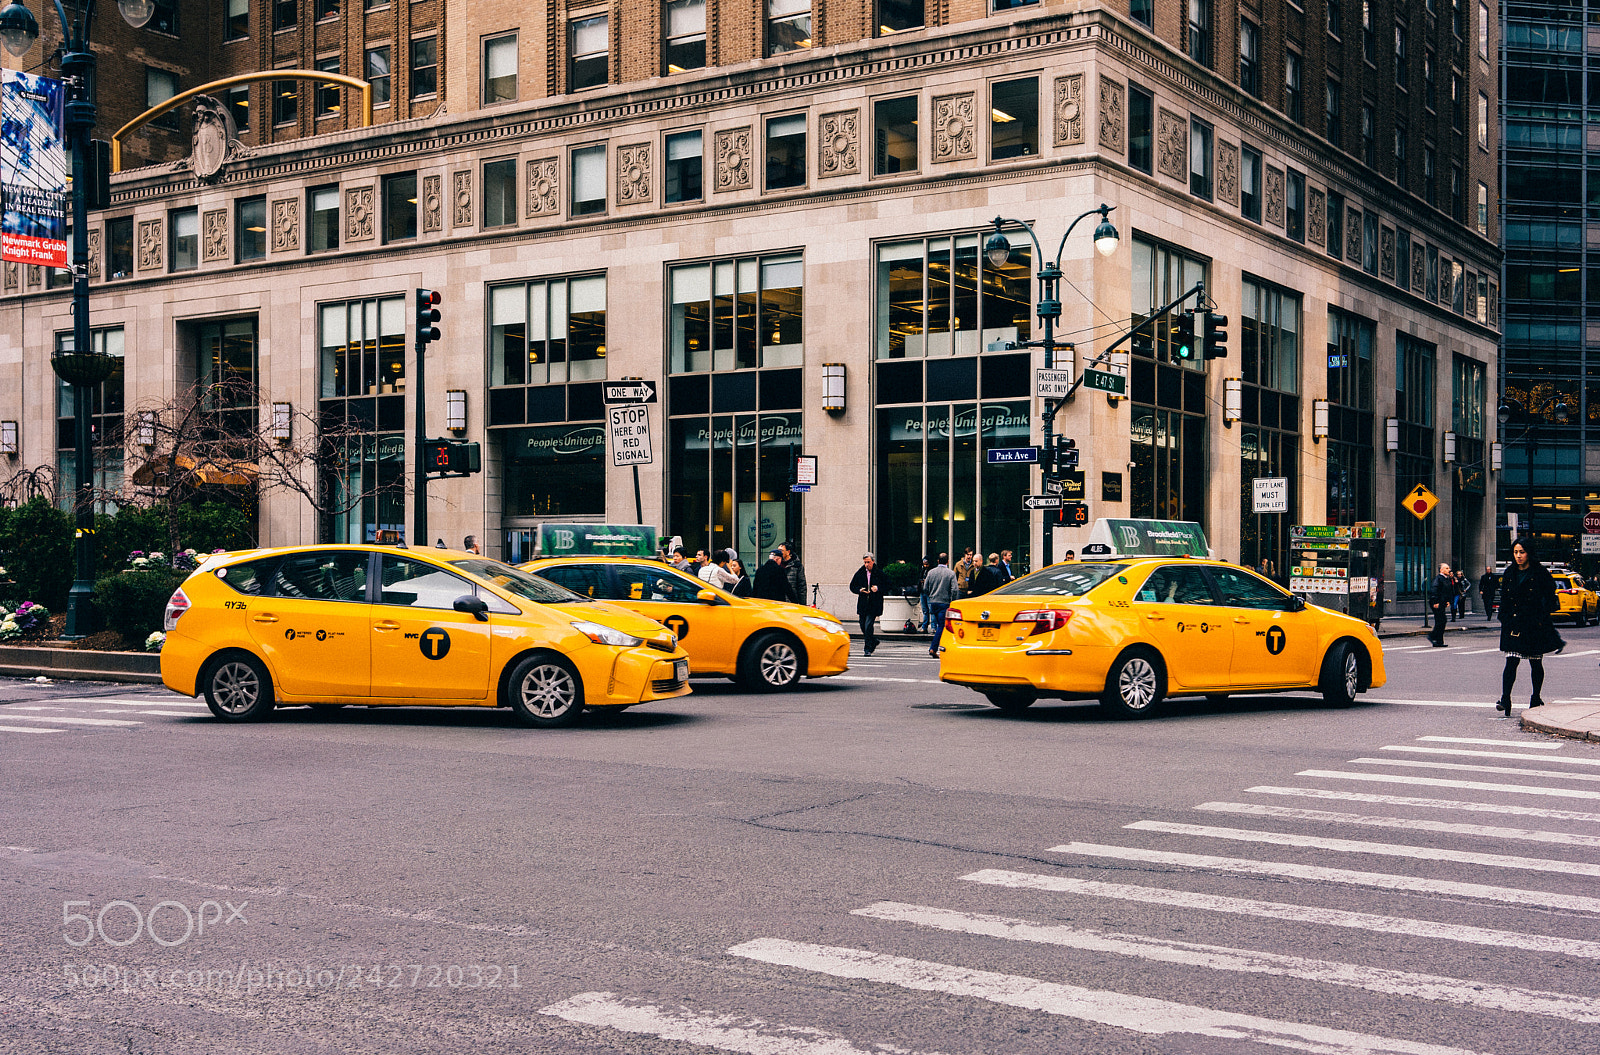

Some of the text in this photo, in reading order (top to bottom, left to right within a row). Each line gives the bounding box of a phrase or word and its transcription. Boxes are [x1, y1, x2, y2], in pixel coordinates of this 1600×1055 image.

[2, 185, 66, 201] NEW YORK CITY:
[23, 197, 53, 208] LEADER
[5, 202, 64, 218] IN REAL ESTATE
[2, 235, 67, 252] Newmark Grubb
[3, 246, 54, 260] Knight Frank
[1038, 372, 1066, 382] PASSENGER
[1095, 374, 1114, 390] E 47 St
[611, 388, 649, 397] ONE WAY
[1038, 384, 1066, 393] CARS ONLY
[613, 410, 645, 424] STOP
[996, 414, 1028, 426] Bank
[614, 426, 647, 436] HERE ON
[564, 435, 594, 446] United
[623, 438, 640, 448] RED
[616, 450, 649, 460] SIGNAL
[995, 452, 1028, 460] Park Ave
[1075, 508, 1085, 520] 26
[1586, 518, 1600, 526] STO
[427, 634, 444, 656] T
[1270, 632, 1282, 651] T
